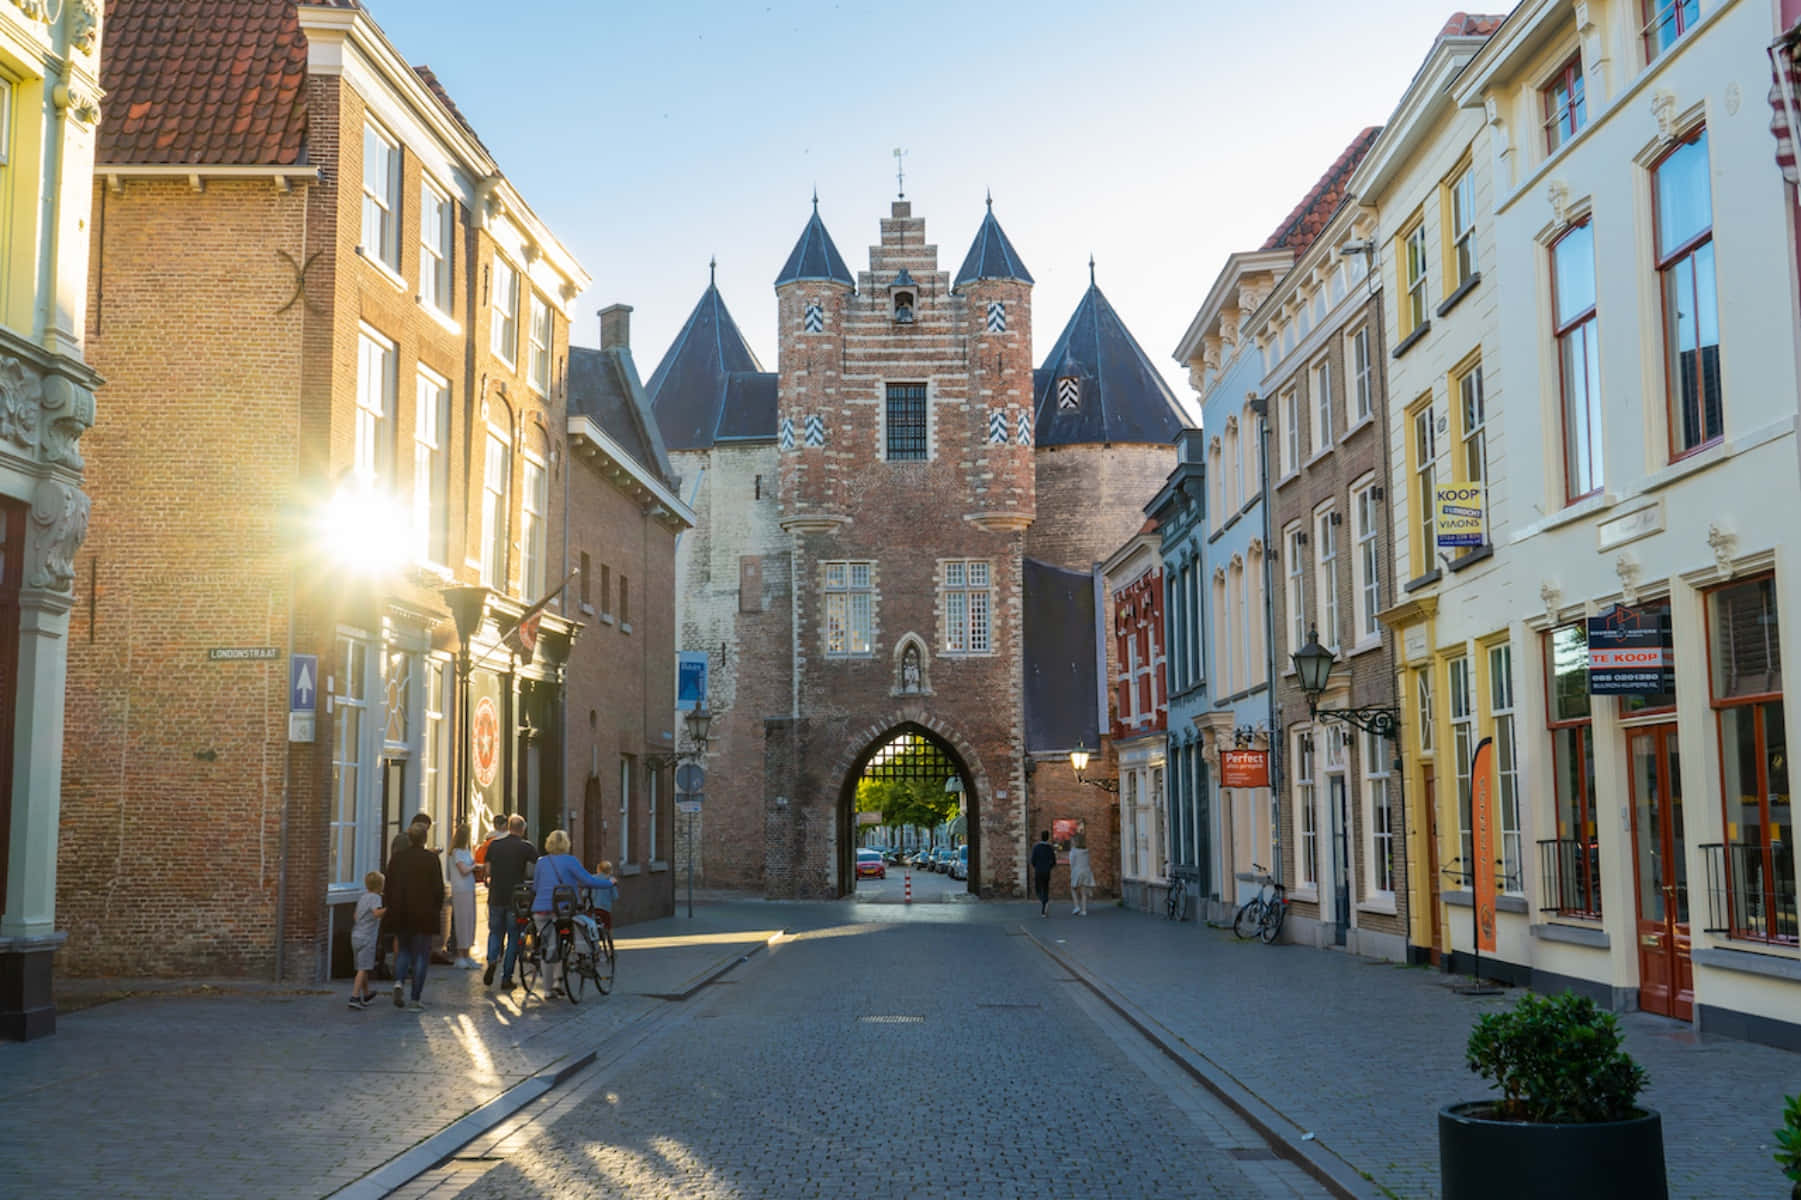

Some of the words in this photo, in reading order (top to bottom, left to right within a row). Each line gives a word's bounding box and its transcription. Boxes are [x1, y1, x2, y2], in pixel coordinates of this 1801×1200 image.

[1438, 489, 1478, 501] KOOP
[1591, 654, 1608, 662] TE
[1614, 653, 1658, 662] KOOP
[1226, 753, 1264, 763] Perfect
